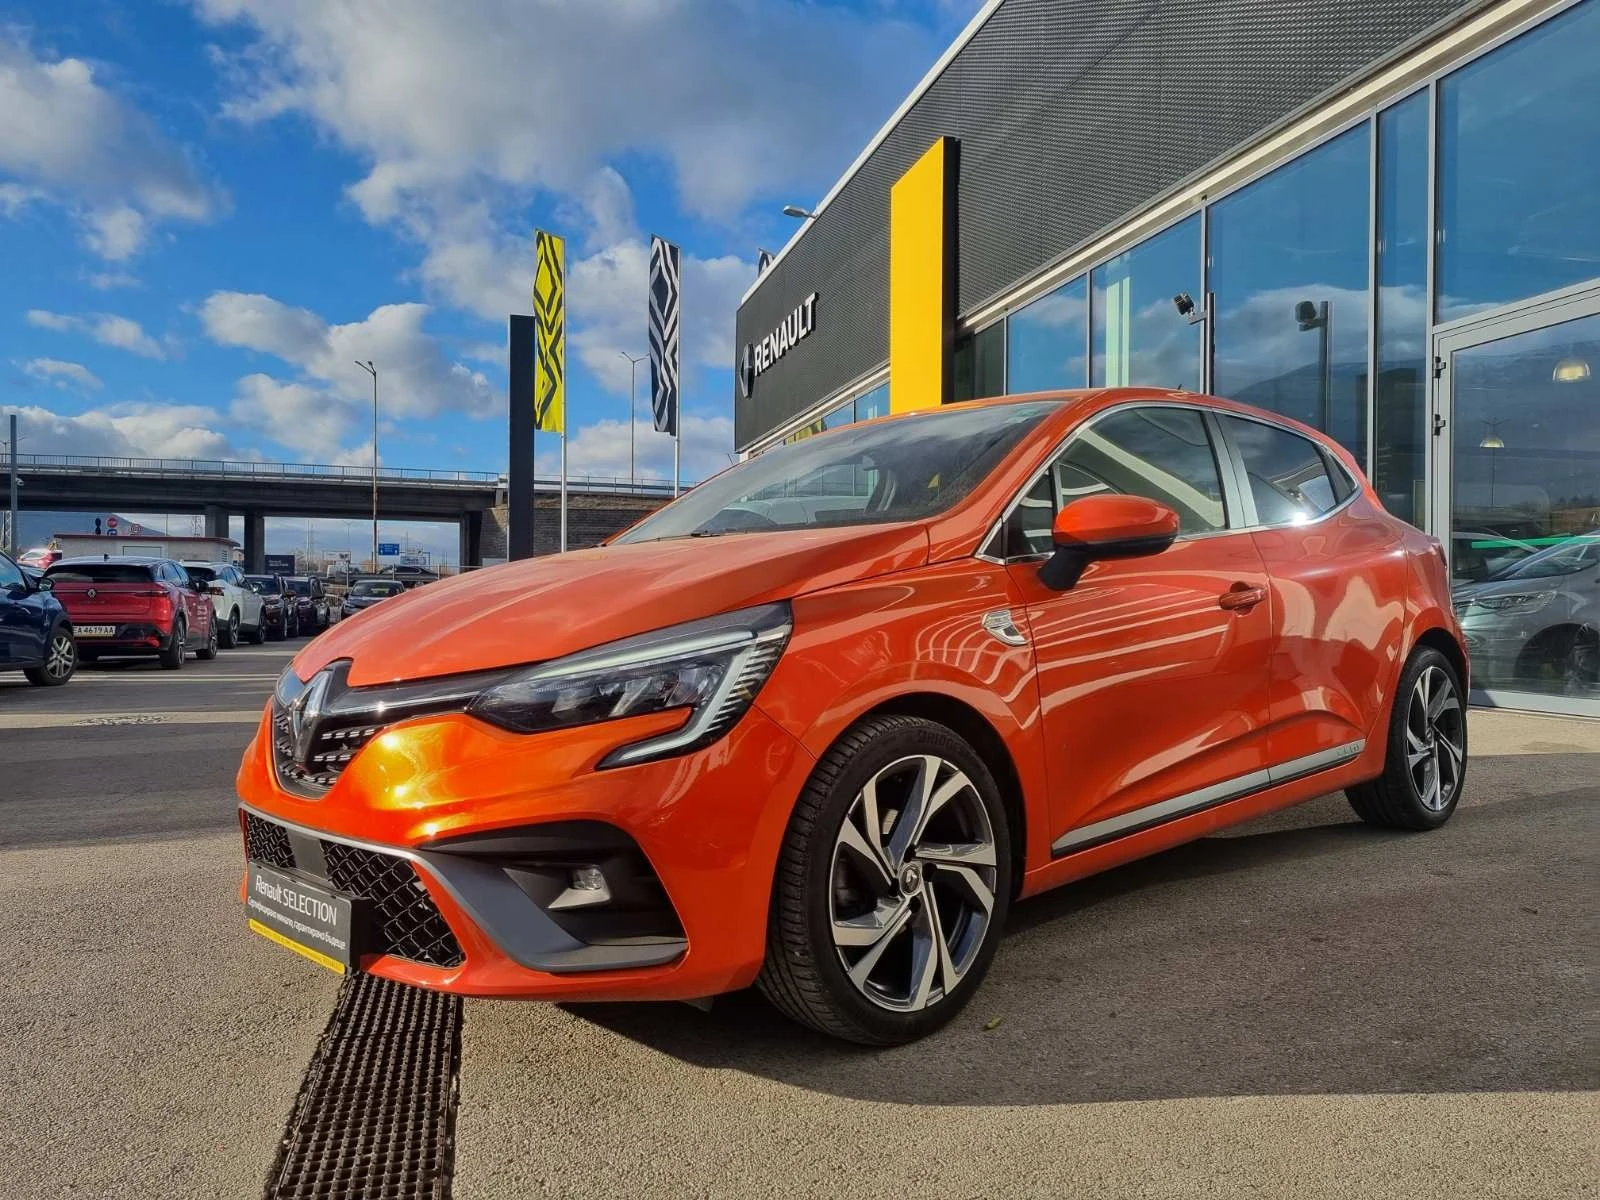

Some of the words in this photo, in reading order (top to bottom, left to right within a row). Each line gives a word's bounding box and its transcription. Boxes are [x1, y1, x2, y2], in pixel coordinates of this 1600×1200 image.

[755, 292, 816, 376] RENAULT
[255, 875, 283, 904] Renault
[283, 888, 337, 926] SELECTION
